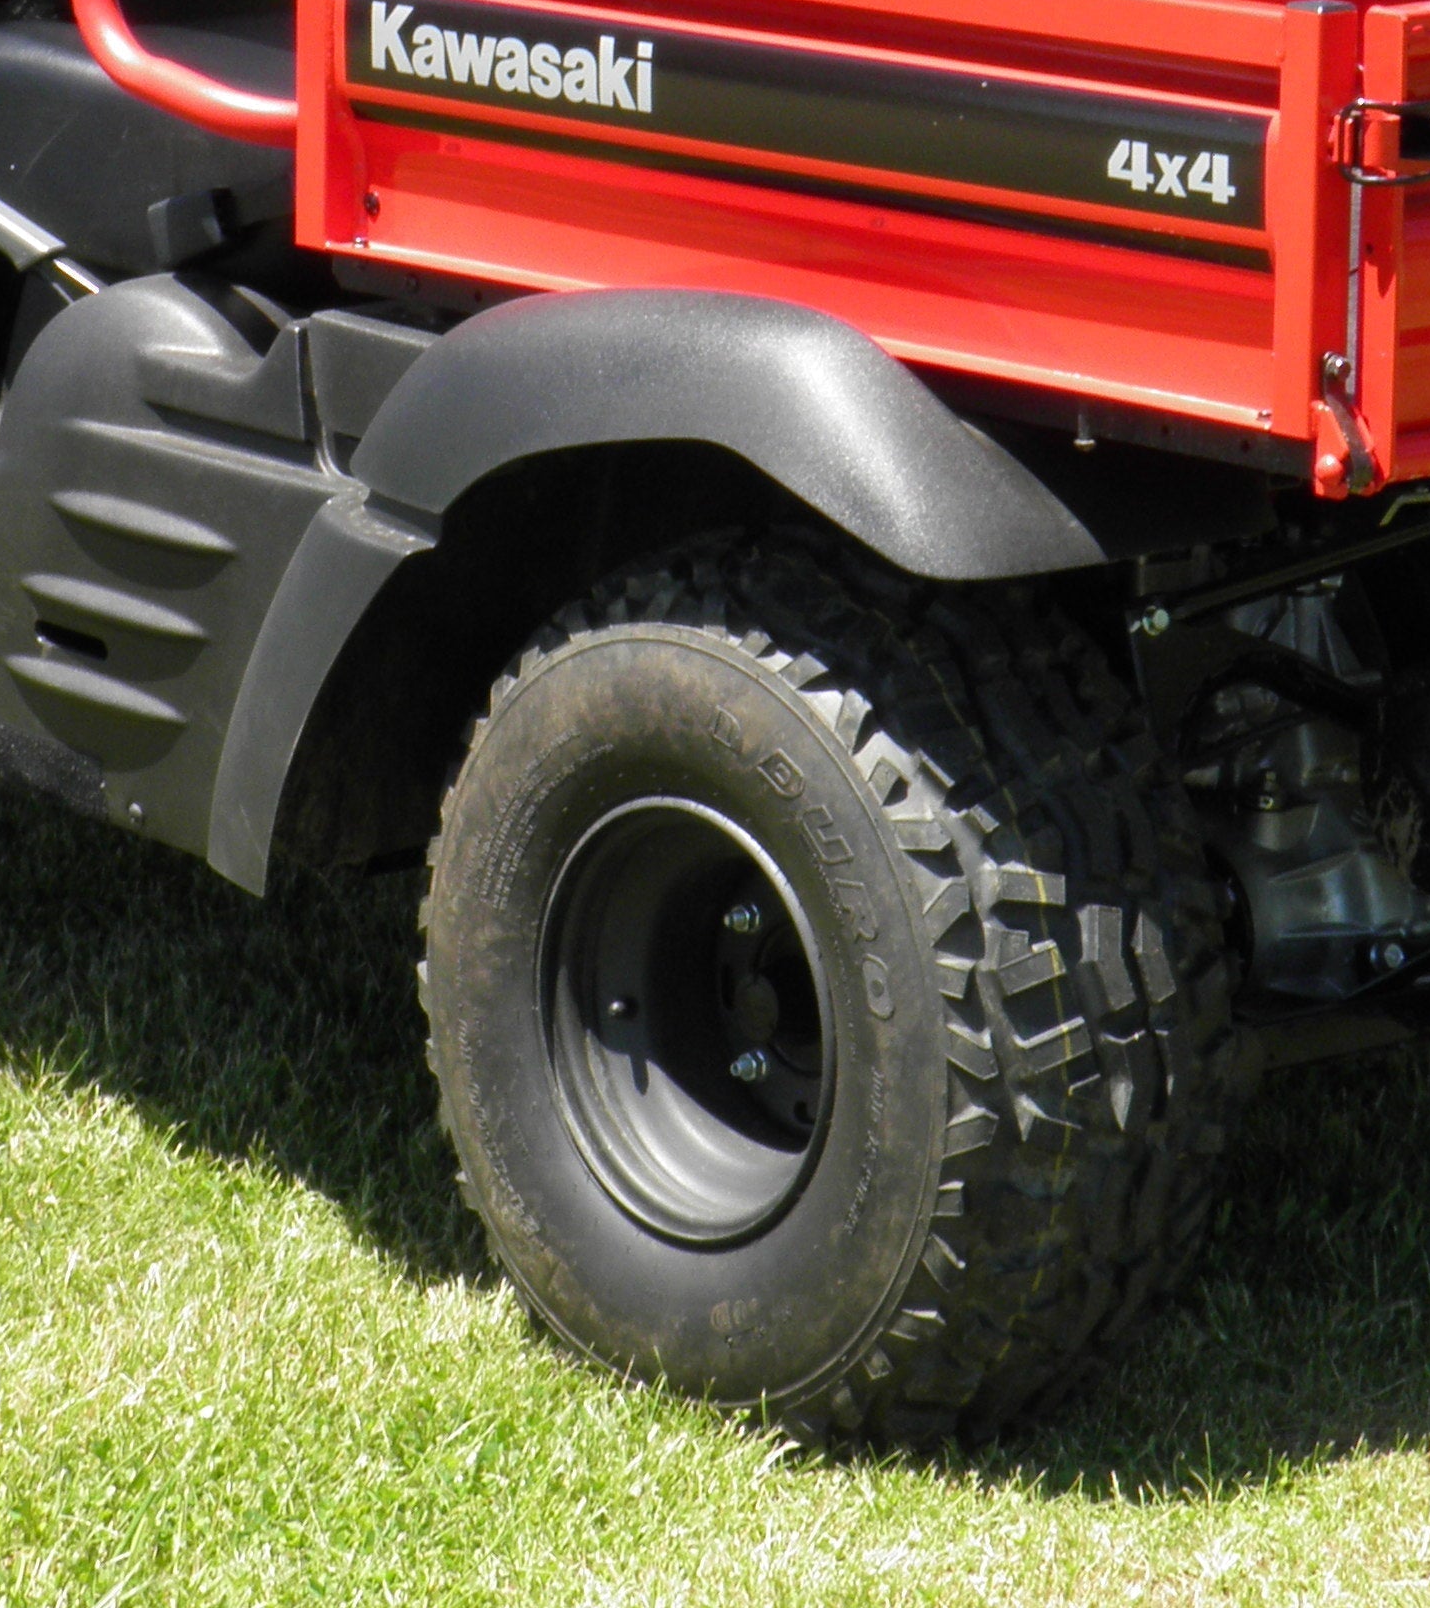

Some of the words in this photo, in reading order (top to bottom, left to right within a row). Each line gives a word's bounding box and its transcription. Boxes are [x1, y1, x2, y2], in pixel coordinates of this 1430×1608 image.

[370, 0, 654, 113] Kawasaki
[1107, 138, 1237, 205] 4x4
[756, 747, 895, 1021] DURO
